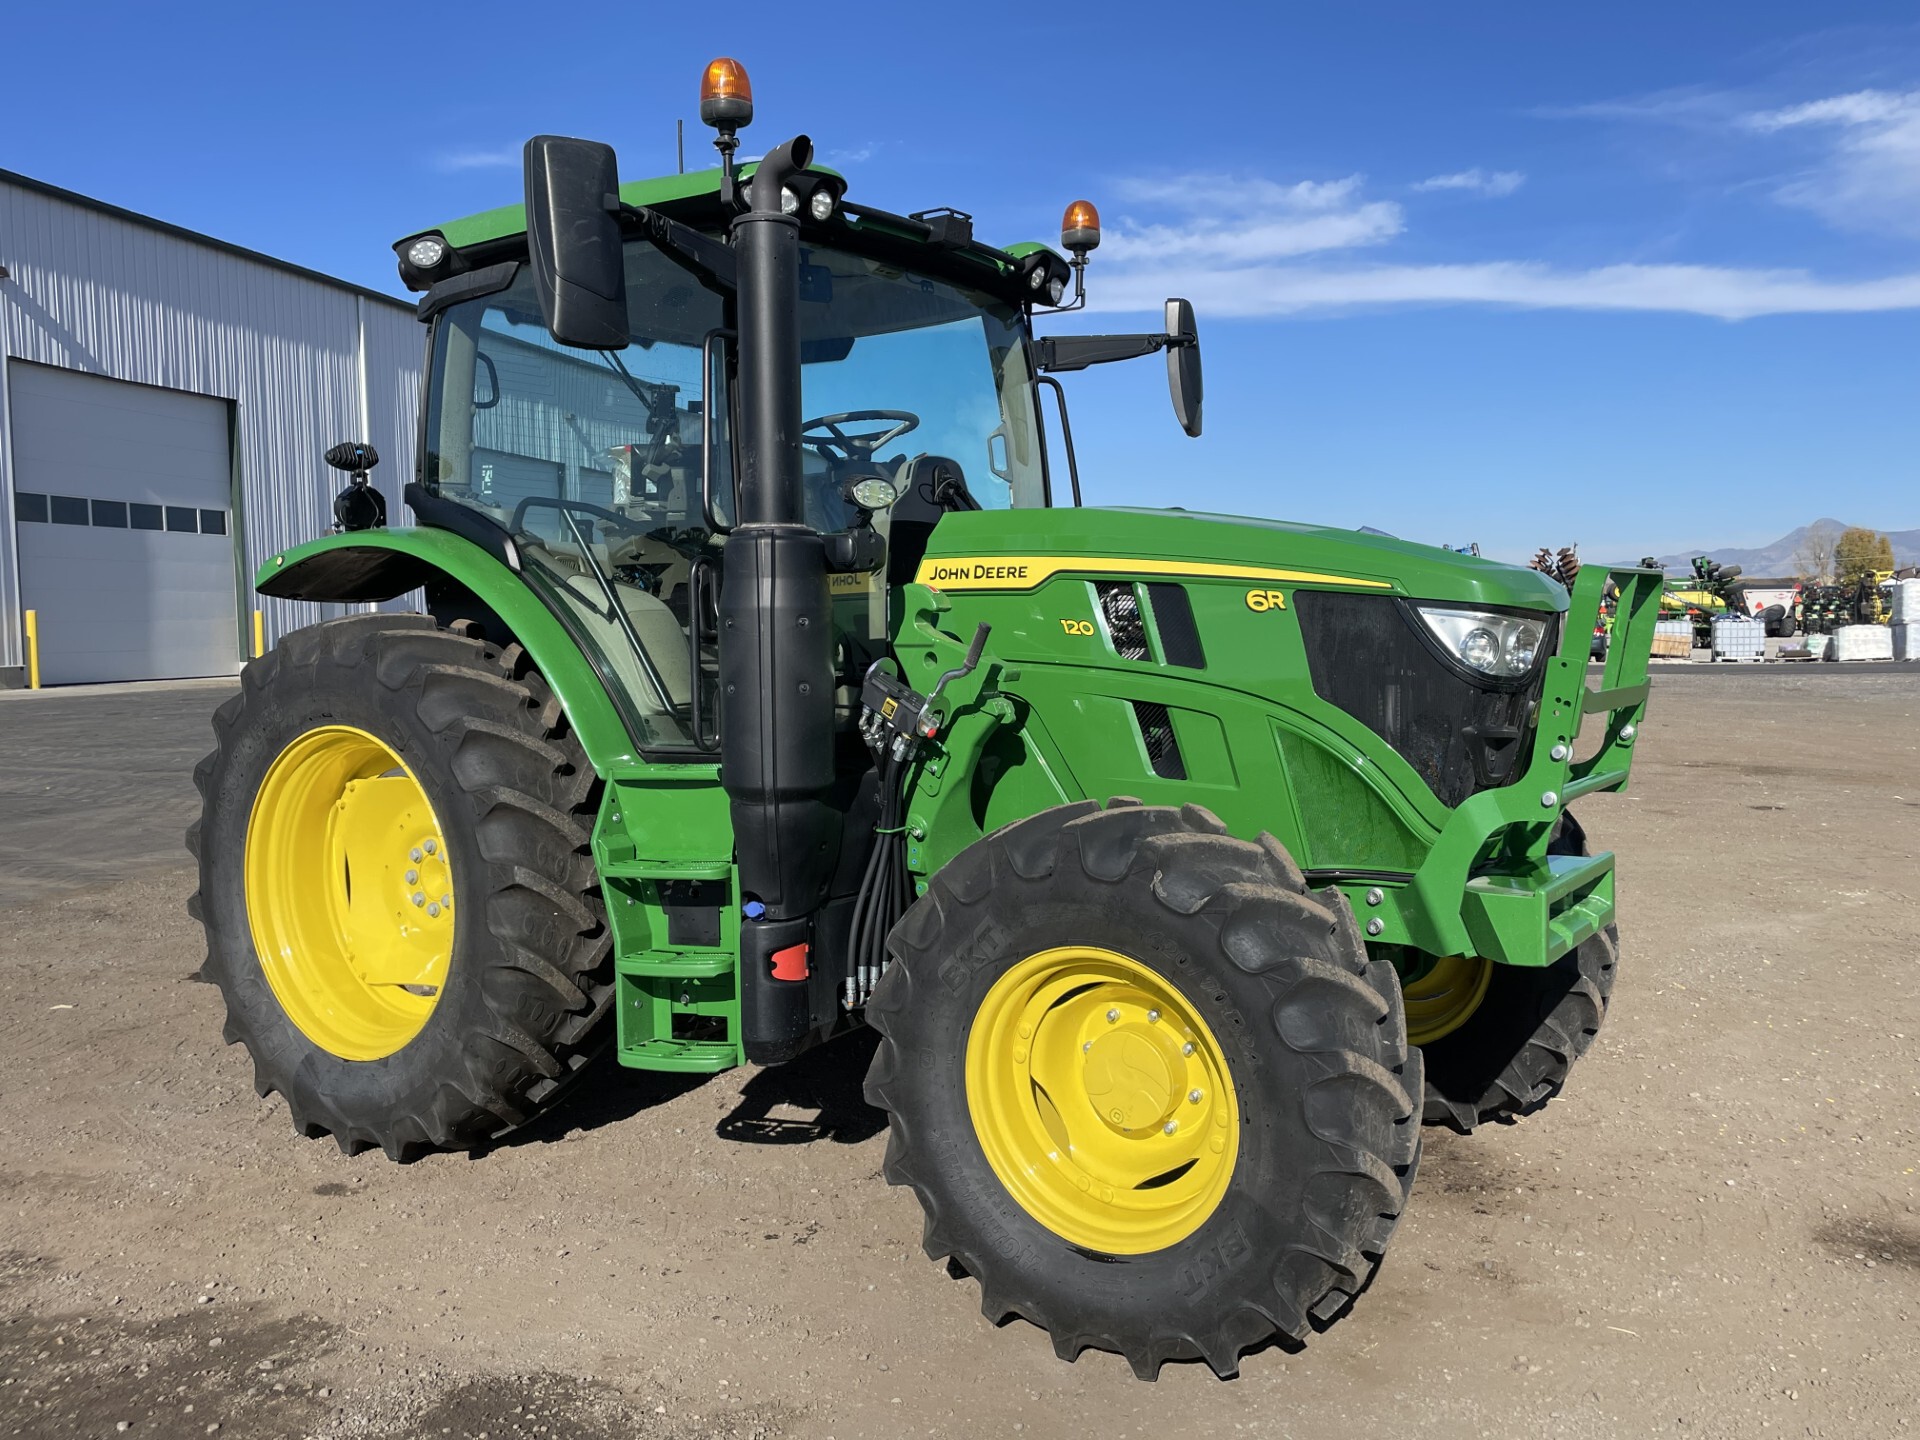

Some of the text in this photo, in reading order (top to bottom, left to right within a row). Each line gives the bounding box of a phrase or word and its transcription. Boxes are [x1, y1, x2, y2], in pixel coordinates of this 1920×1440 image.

[930, 565, 1028, 581] JOHN DEERE
[1245, 589, 1287, 612] 6R
[1059, 618, 1095, 636] 120
[937, 915, 1007, 998] BKT
